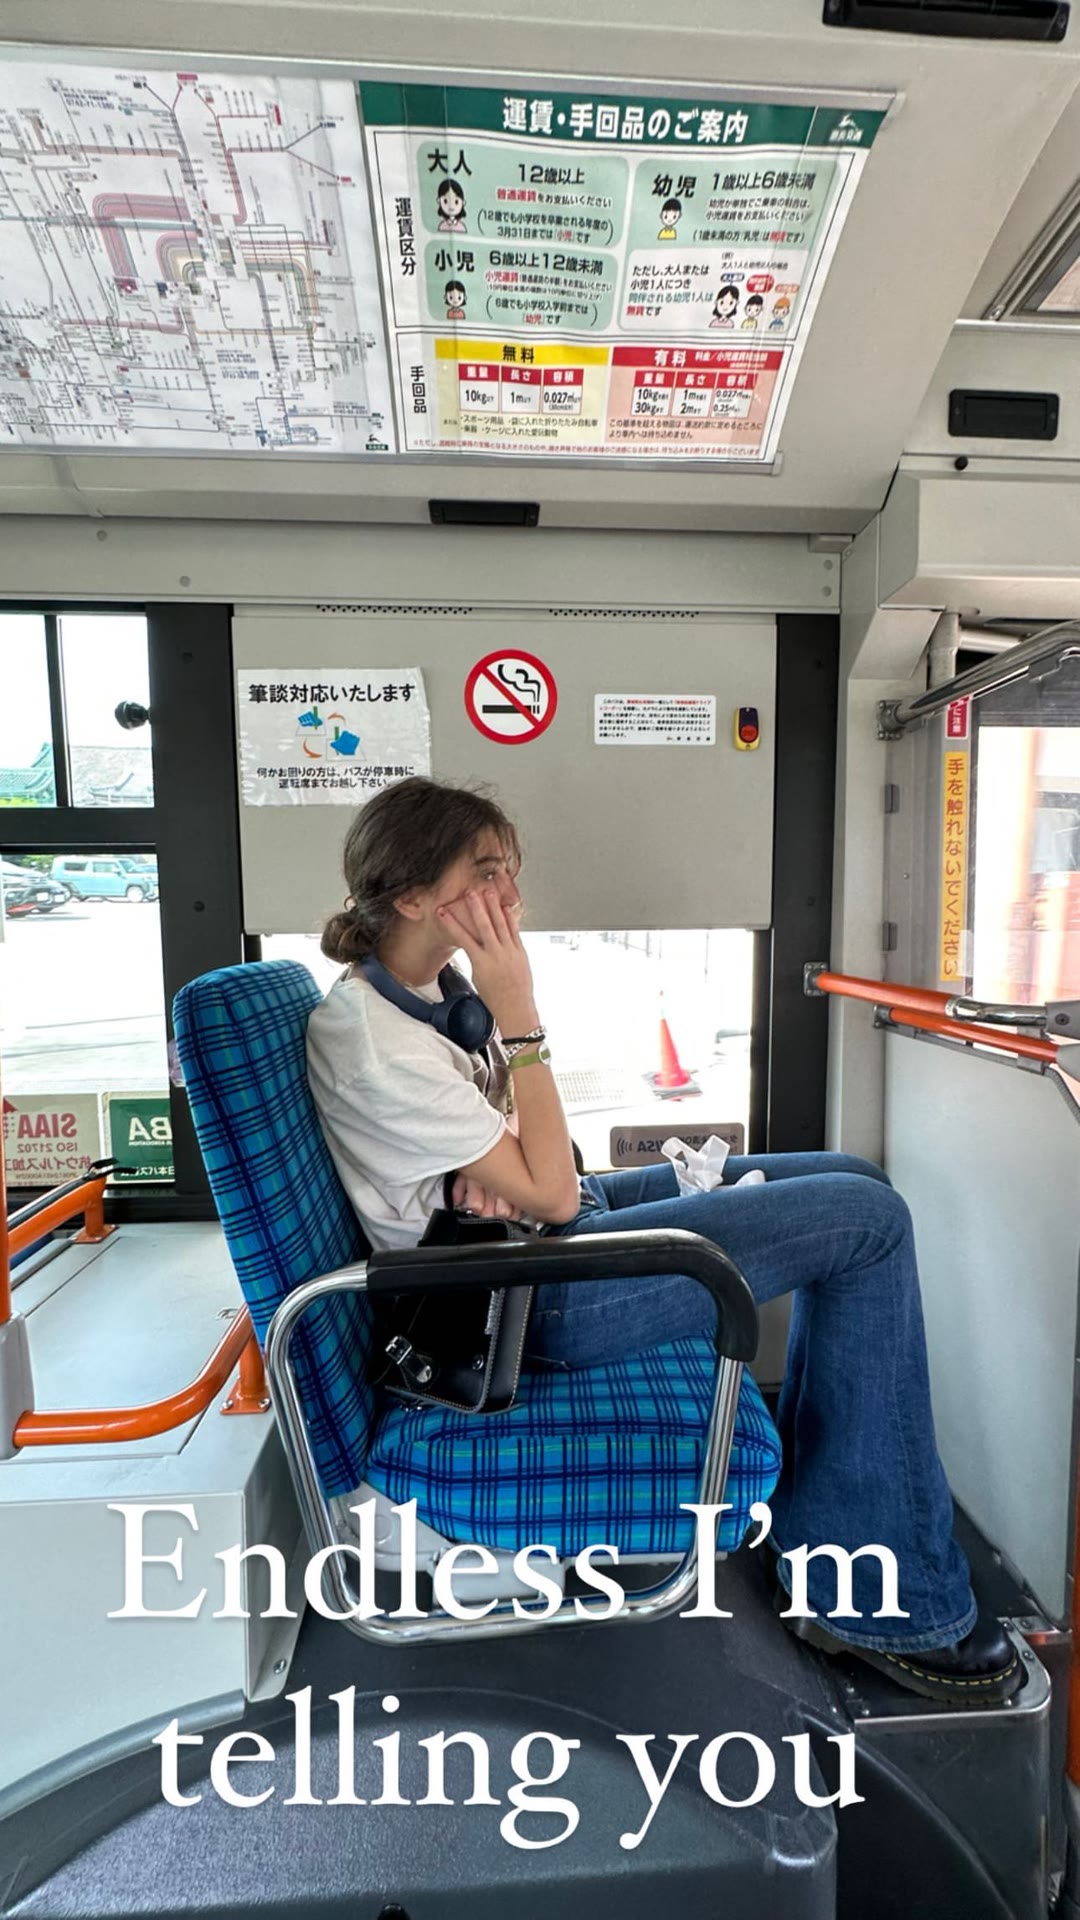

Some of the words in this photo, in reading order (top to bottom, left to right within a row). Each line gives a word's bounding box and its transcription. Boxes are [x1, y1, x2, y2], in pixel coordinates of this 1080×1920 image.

[502, 96, 749, 143] 運賃・手回品のご案内
[427, 148, 472, 176] 大人
[518, 163, 585, 184] 12歳以上
[652, 173, 697, 198] 幼児
[711, 170, 816, 191] 1歳以上6歳未満
[395, 197, 416, 276] 運賃区分
[434, 249, 474, 272] 小児
[489, 250, 603, 276] 6歳以上12歳未満
[630, 279, 692, 291] 小児1人につき
[502, 345, 535, 363] 無料
[654, 349, 687, 367] 有料
[510, 369, 532, 382] 長さ
[410, 365, 427, 414] 手回品
[249, 683, 415, 703] 筆談対応いたします
[943, 758, 964, 976] 手を触れないでください
